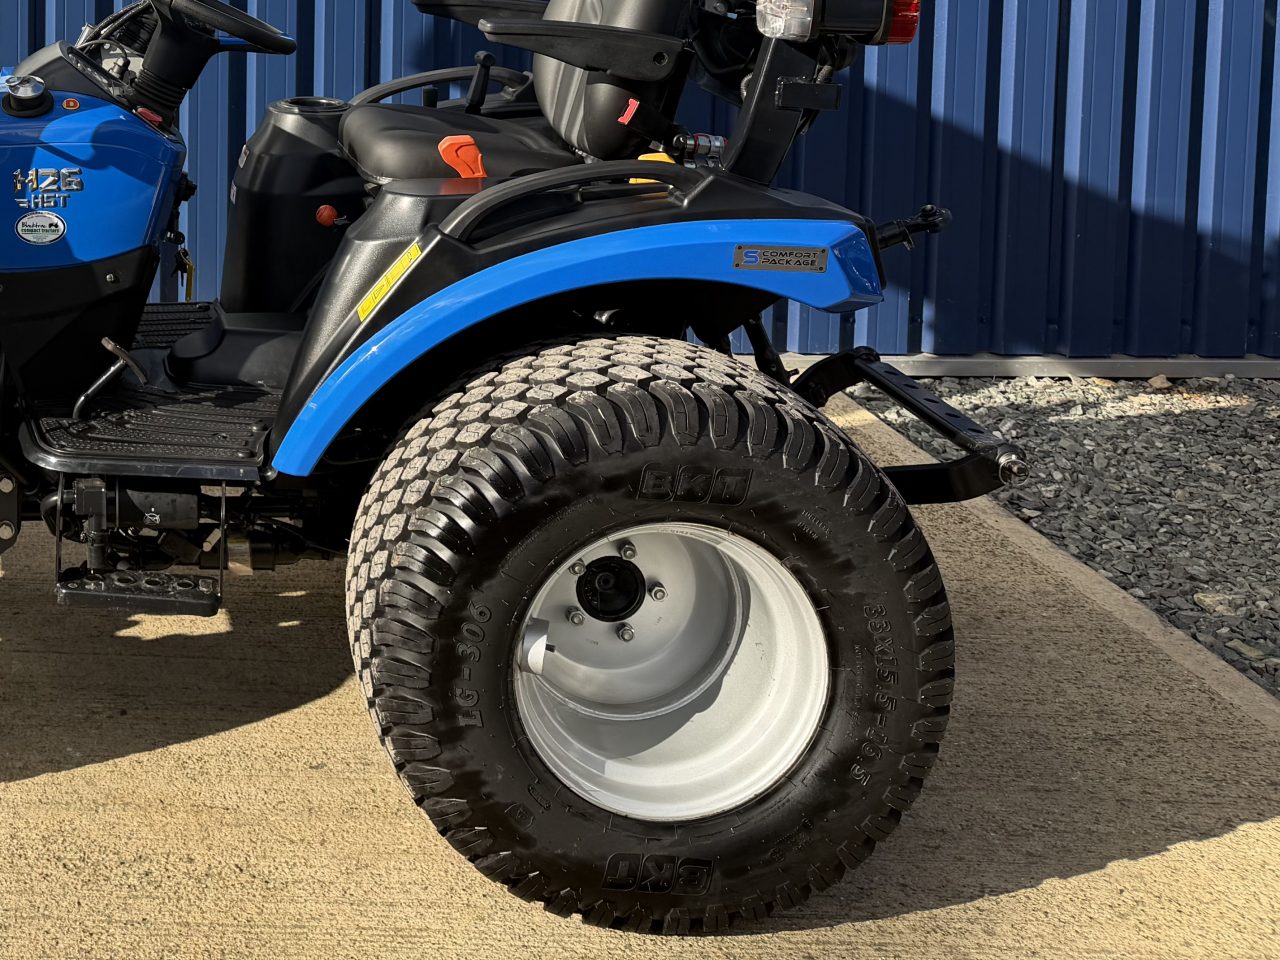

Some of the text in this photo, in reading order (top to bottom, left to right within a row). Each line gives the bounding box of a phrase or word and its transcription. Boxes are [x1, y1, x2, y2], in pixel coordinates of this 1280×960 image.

[762, 251, 819, 259] COMFORT
[761, 259, 818, 267] PACKAGE
[454, 600, 492, 728] LG-306
